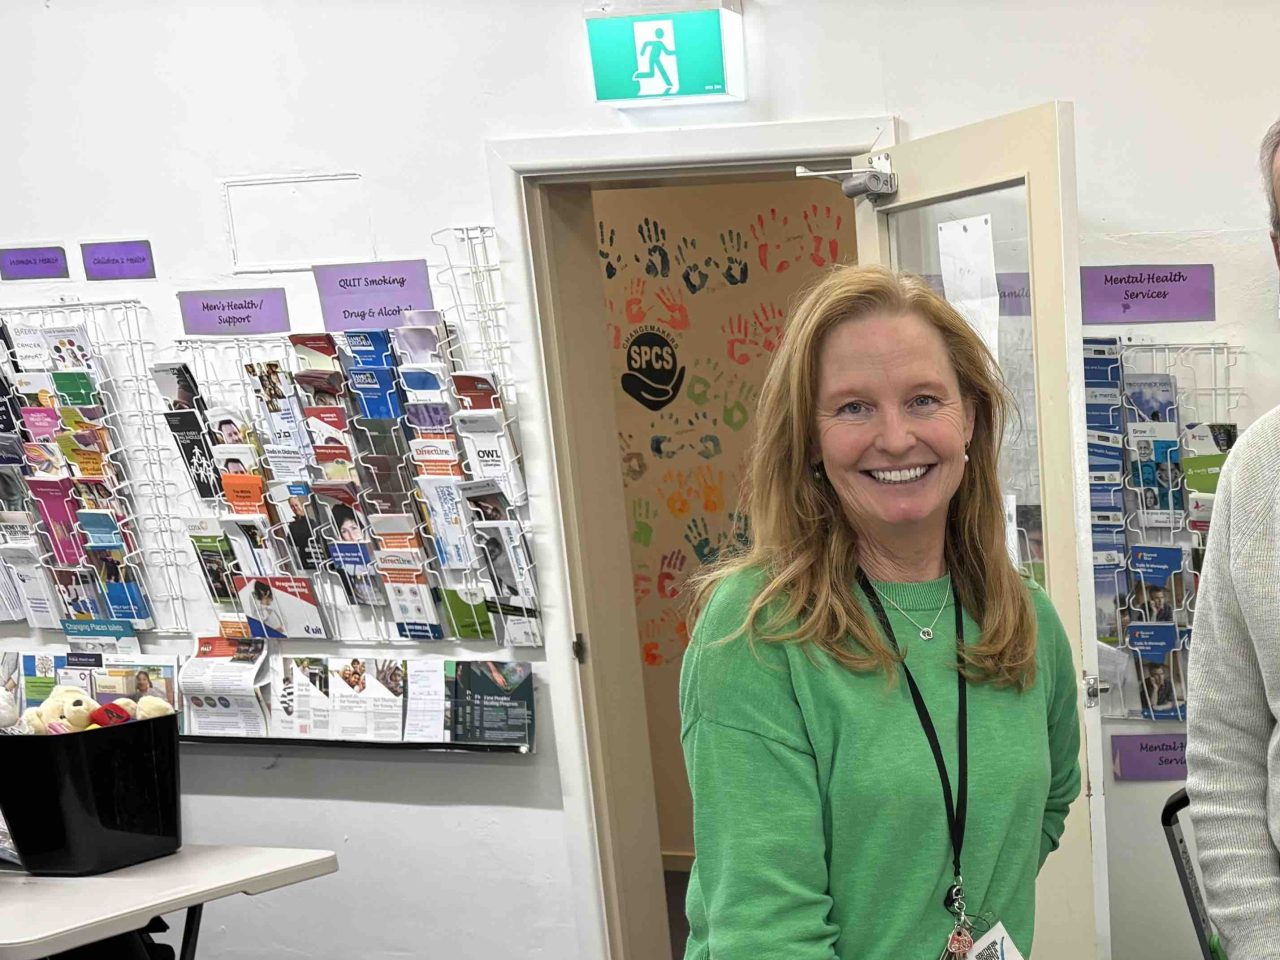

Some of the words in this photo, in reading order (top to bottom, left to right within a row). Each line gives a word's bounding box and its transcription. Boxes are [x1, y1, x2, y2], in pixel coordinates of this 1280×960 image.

[338, 277, 362, 289] QUIT
[363, 276, 407, 288] Smoking
[1103, 273, 1145, 286] Mental
[1146, 271, 1188, 284] Health
[1123, 289, 1169, 301] Services
[202, 300, 225, 313] Men's
[226, 299, 257, 312] Health
[217, 313, 252, 327] Support
[621, 324, 679, 350] CHANGEMAKERS
[630, 344, 674, 371] SPCS
[477, 449, 502, 460] OWL
[1139, 742, 1177, 753] Mental
